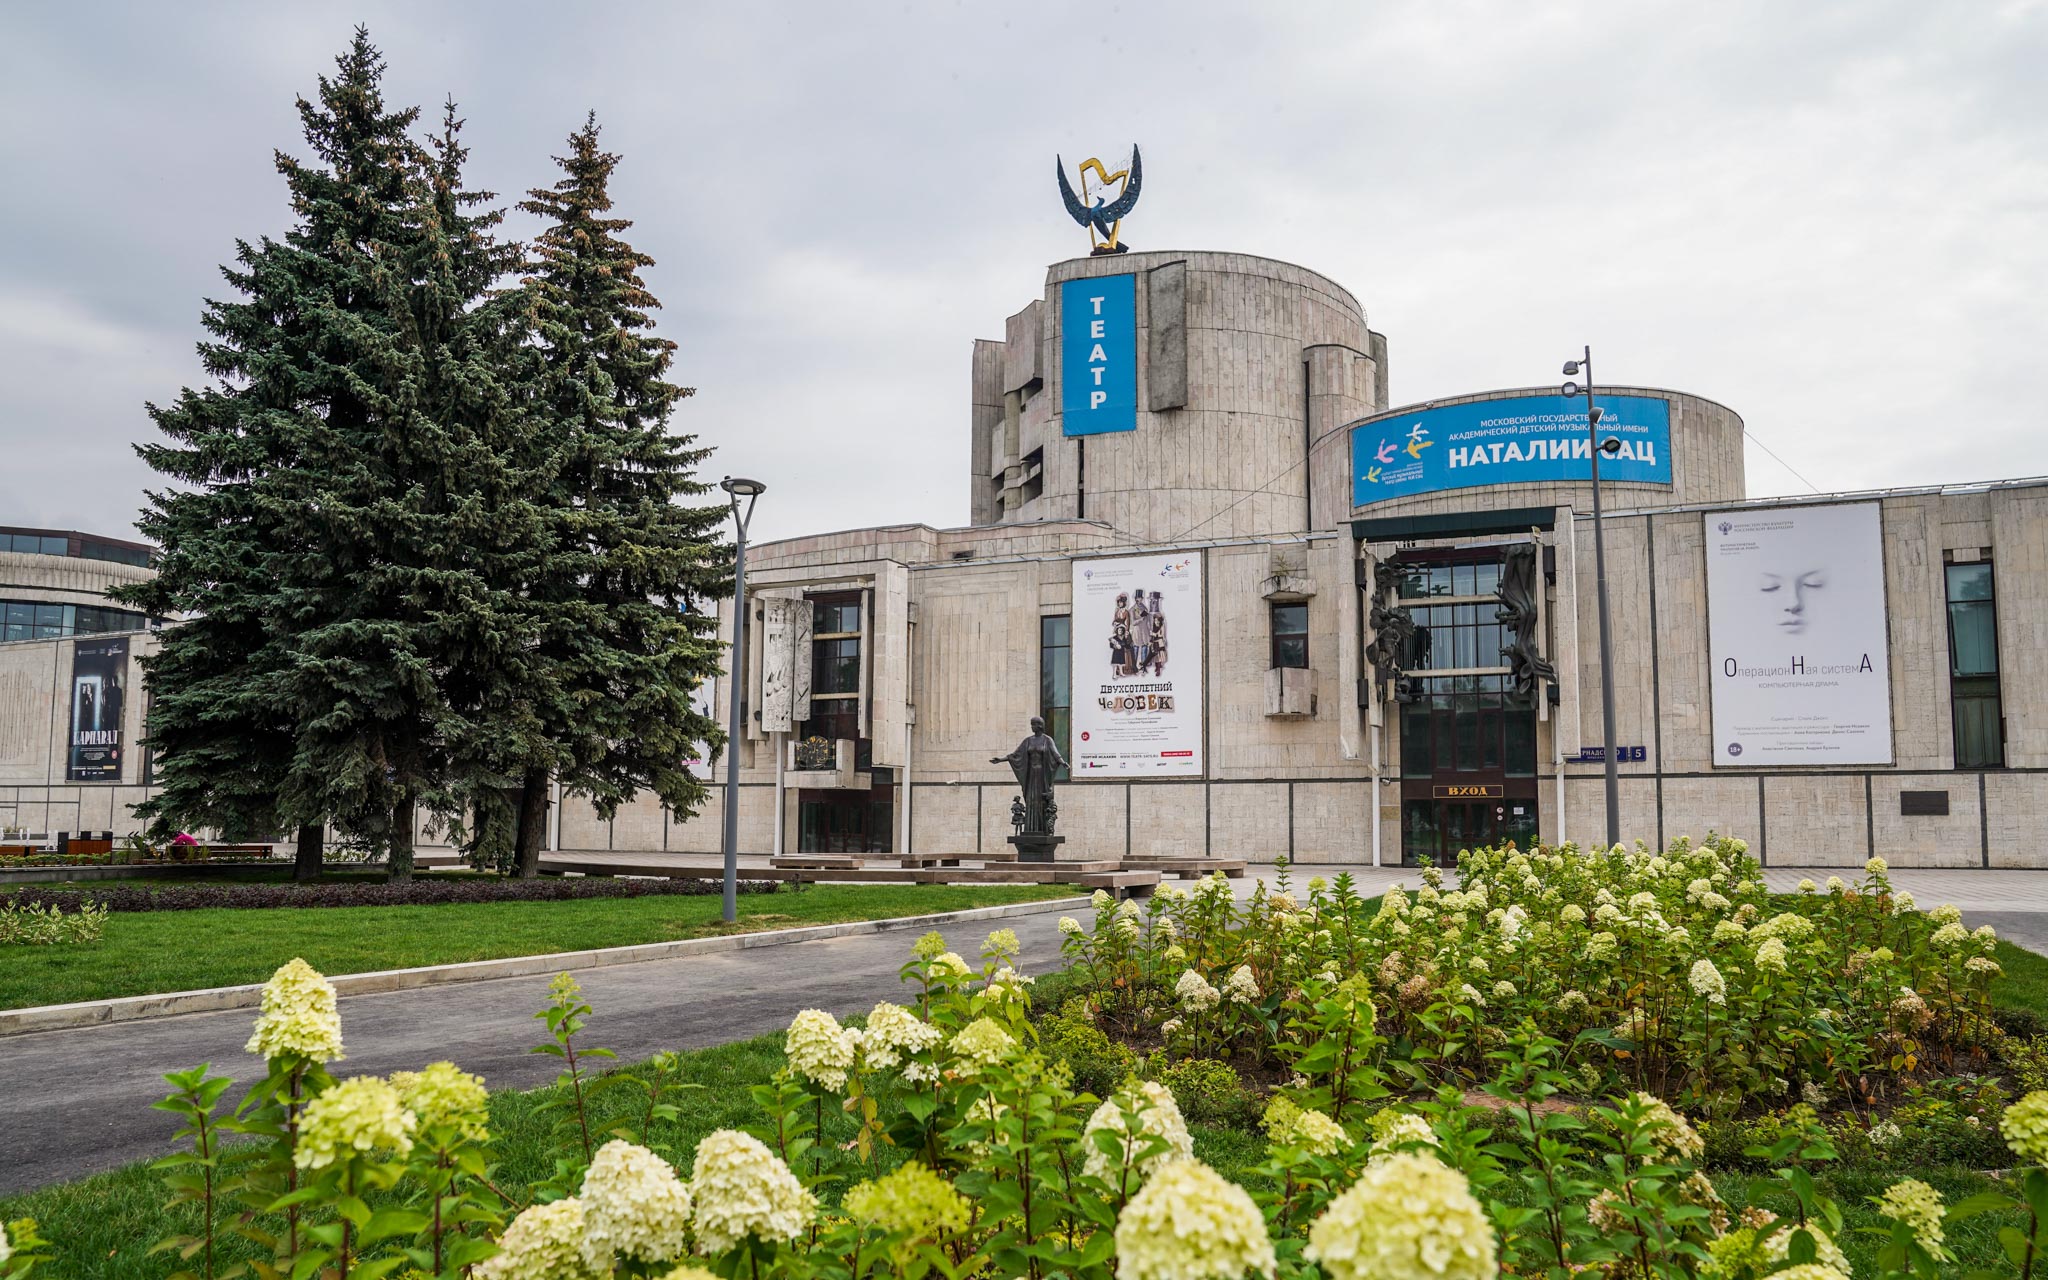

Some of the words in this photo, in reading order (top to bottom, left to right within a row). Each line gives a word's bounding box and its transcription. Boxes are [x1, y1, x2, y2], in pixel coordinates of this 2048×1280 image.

[1088, 296, 1107, 410] ТЕАТР
[1480, 414, 1537, 427] МОСКОВСКИЙ
[1538, 413, 1618, 423] ГОСУДАРСТВНЫЙ
[1449, 425, 1518, 441] АКАДЕМИЧЕСКИЙ
[1519, 423, 1557, 434] ДЕТСКИЙ
[1558, 423, 1621, 433] МУЗЫКЬНЫЙ
[1622, 425, 1649, 433] ИМЕНИ
[1449, 438, 1592, 469] НАТАЛИИ
[1100, 681, 1173, 694] ДВУХСОТЛЕТНИЙ
[1758, 681, 1814, 689] КОМПЬЮТЕРНАЯ
[1635, 748, 1642, 758] 5
[1448, 786, 1488, 796] ВХОД
